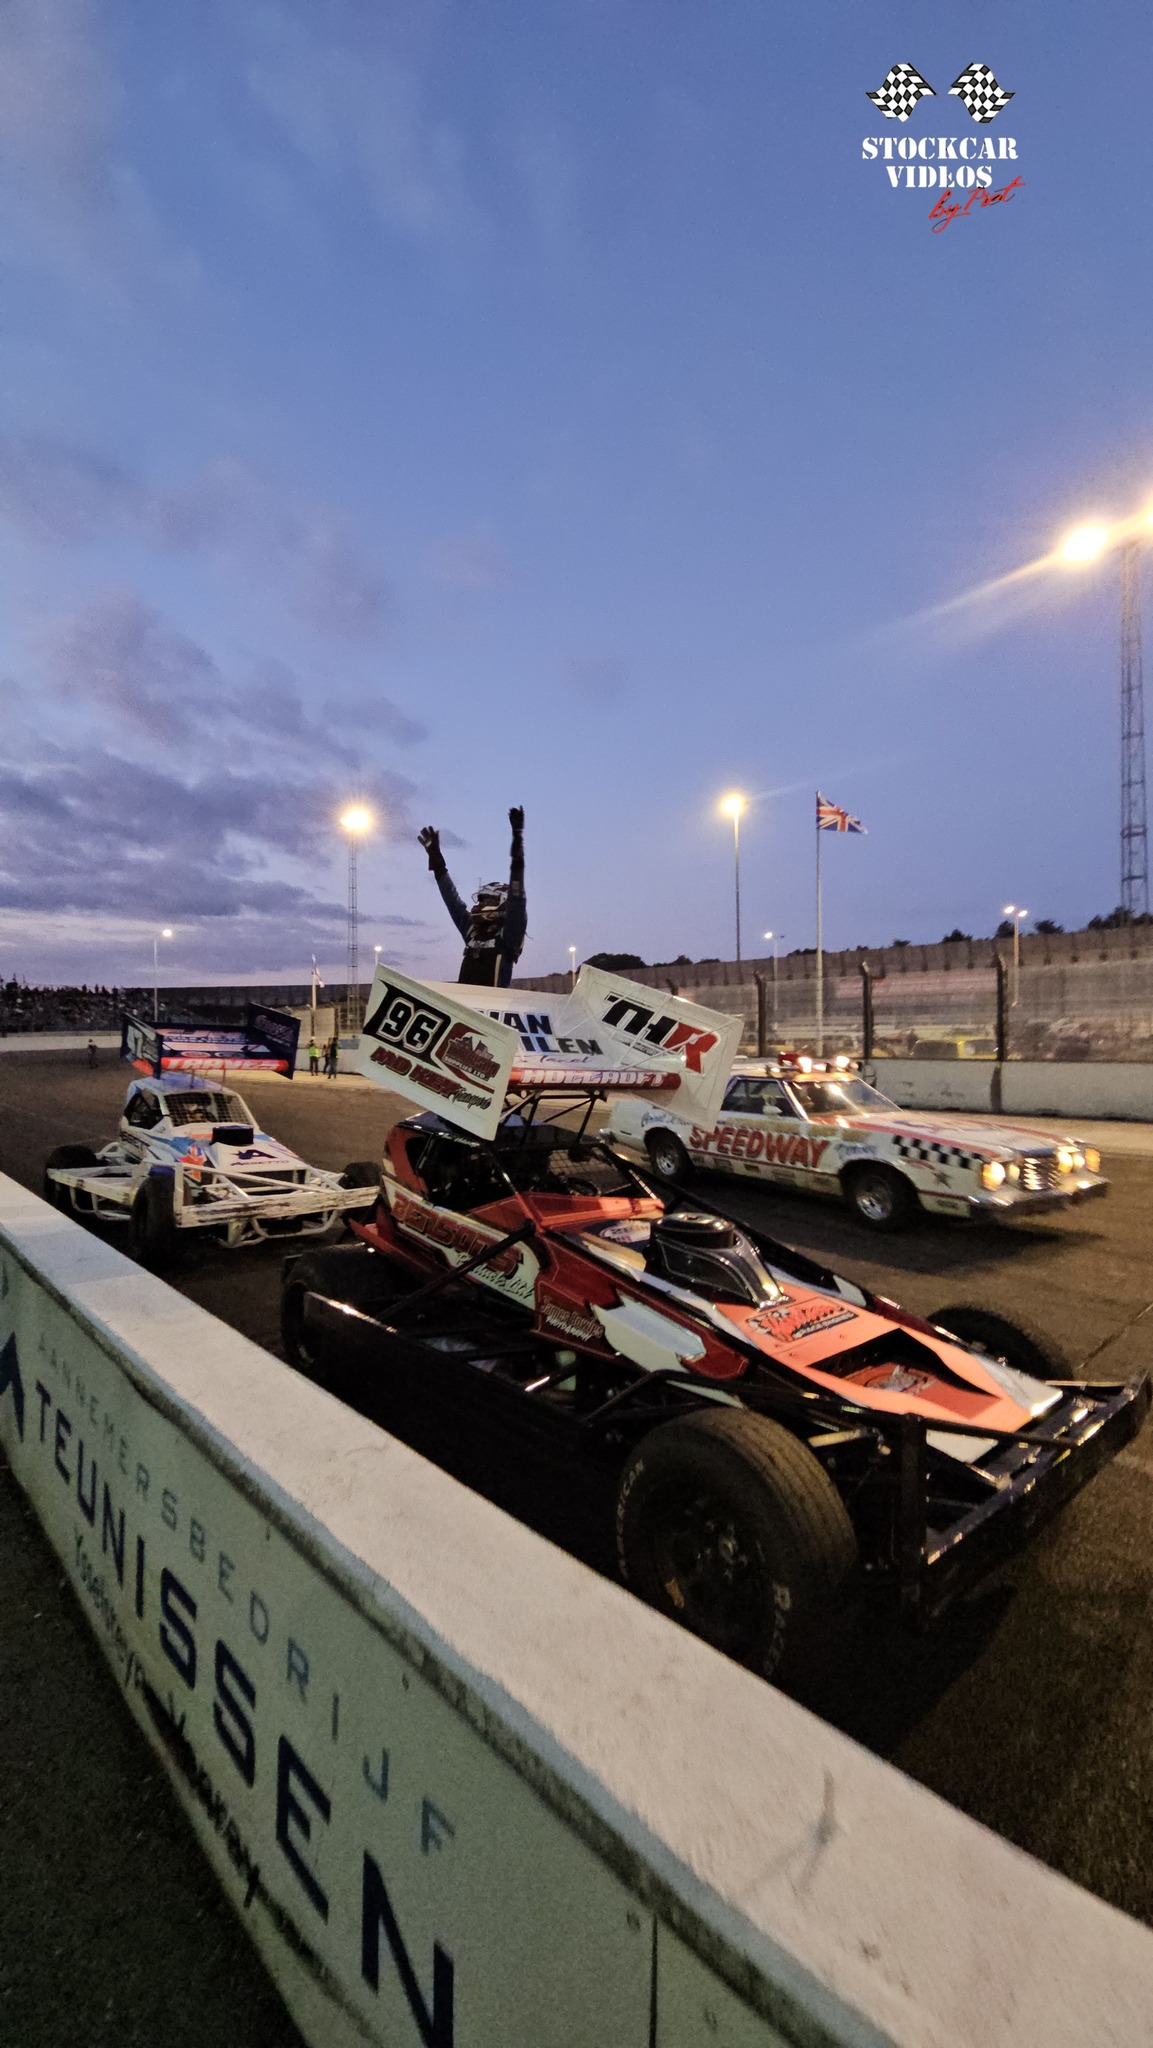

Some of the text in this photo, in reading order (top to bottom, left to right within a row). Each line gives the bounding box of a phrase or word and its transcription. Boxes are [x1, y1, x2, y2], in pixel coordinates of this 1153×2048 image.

[376, 997, 443, 1053] 96
[688, 1125, 831, 1169] SPEEDWAY
[35, 1379, 454, 2048] TEUNISSEN
